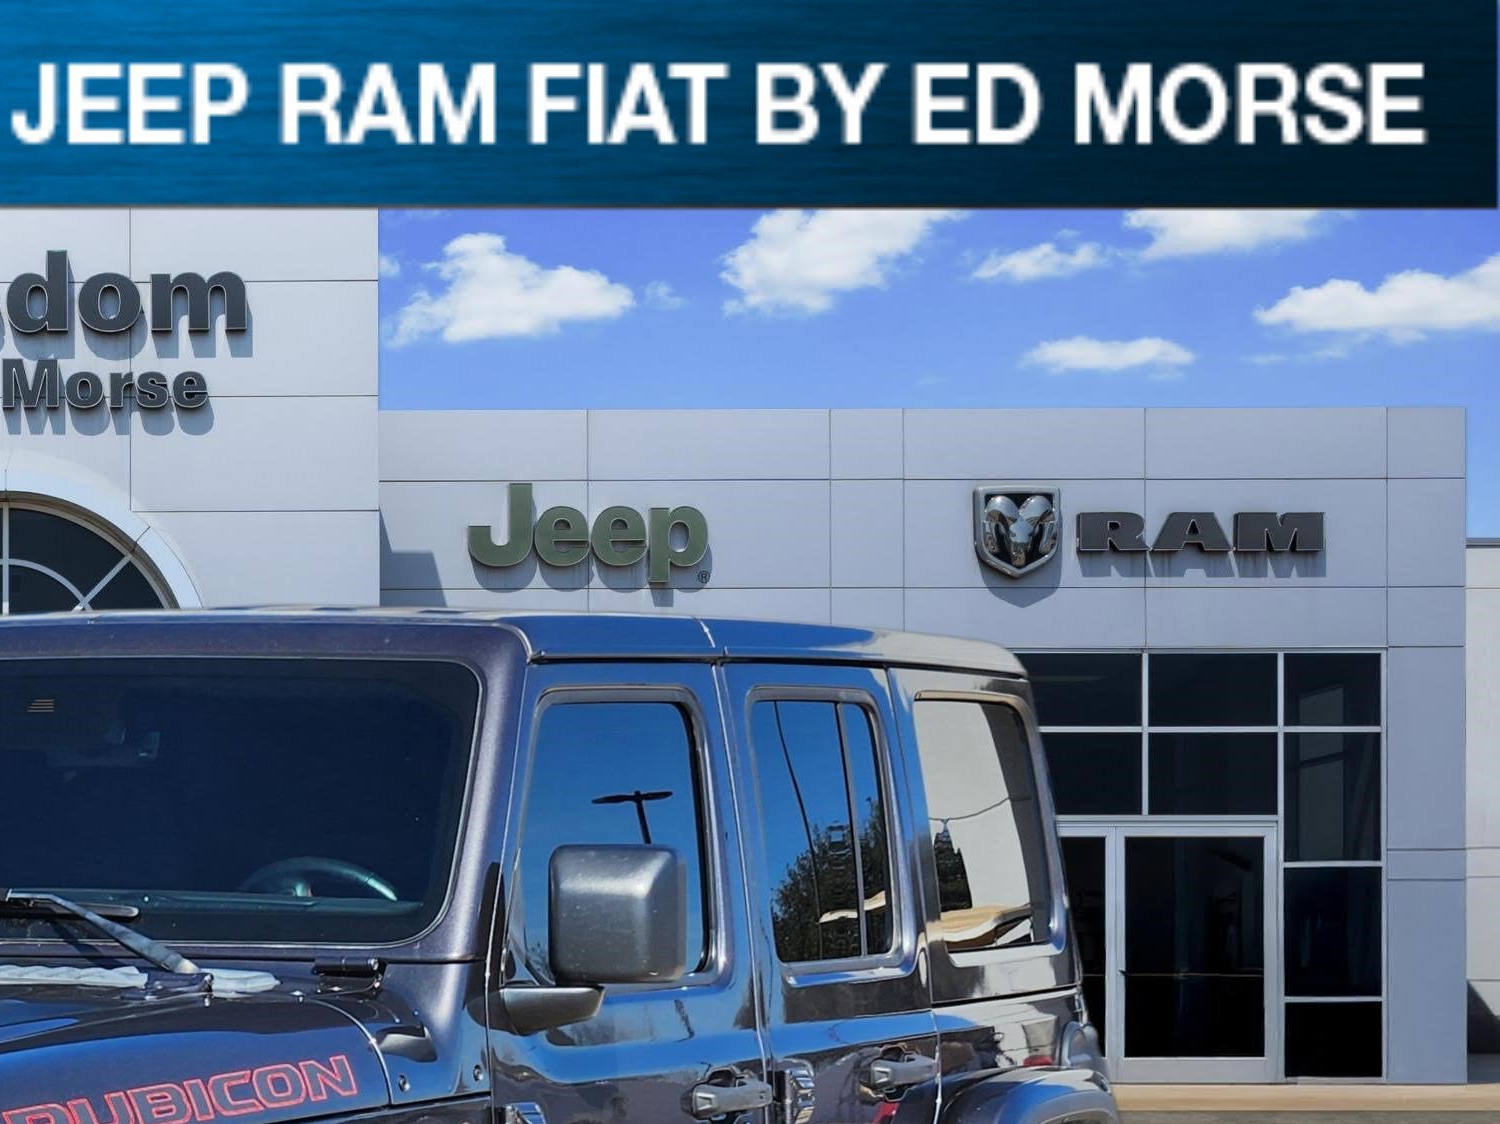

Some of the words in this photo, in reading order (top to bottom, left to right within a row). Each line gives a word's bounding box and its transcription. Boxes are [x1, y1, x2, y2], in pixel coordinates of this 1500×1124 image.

[2, 358, 209, 408] Morse
[467, 483, 708, 583] Jeep
[1076, 511, 1325, 551] RAM
